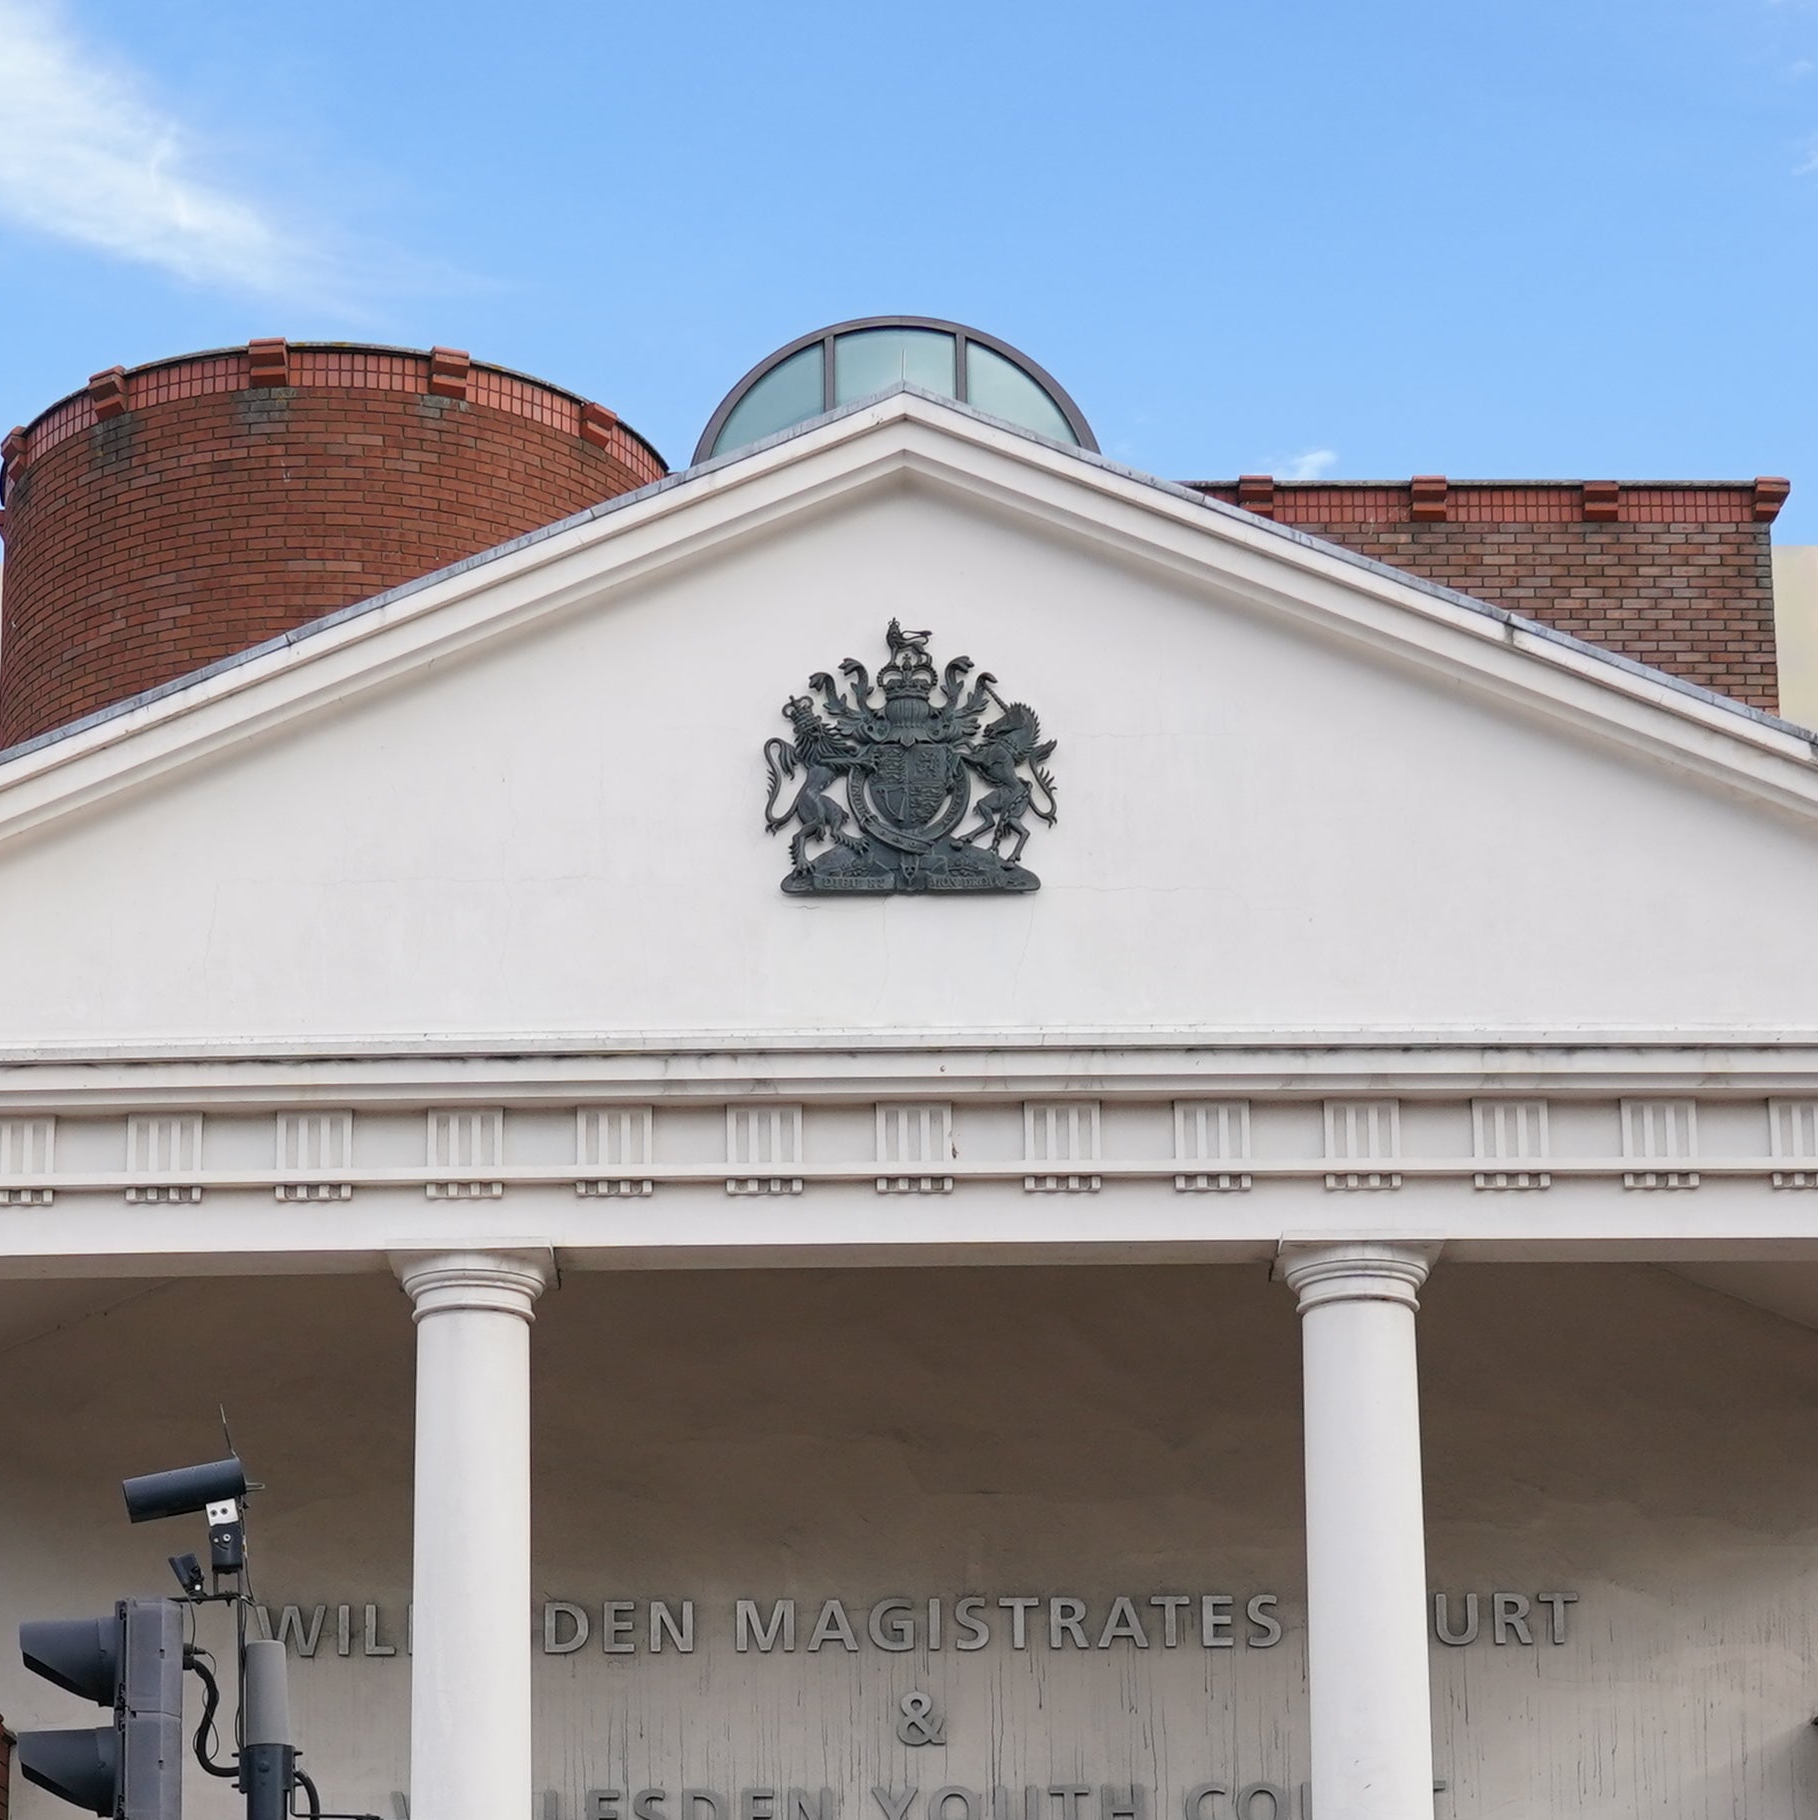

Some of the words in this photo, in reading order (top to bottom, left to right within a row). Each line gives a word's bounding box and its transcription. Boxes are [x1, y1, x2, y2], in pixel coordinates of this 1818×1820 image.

[735, 1594, 1283, 1654] MAGISTRATES
[1435, 1592, 1579, 1648] URT
[897, 1691, 946, 1747] &
